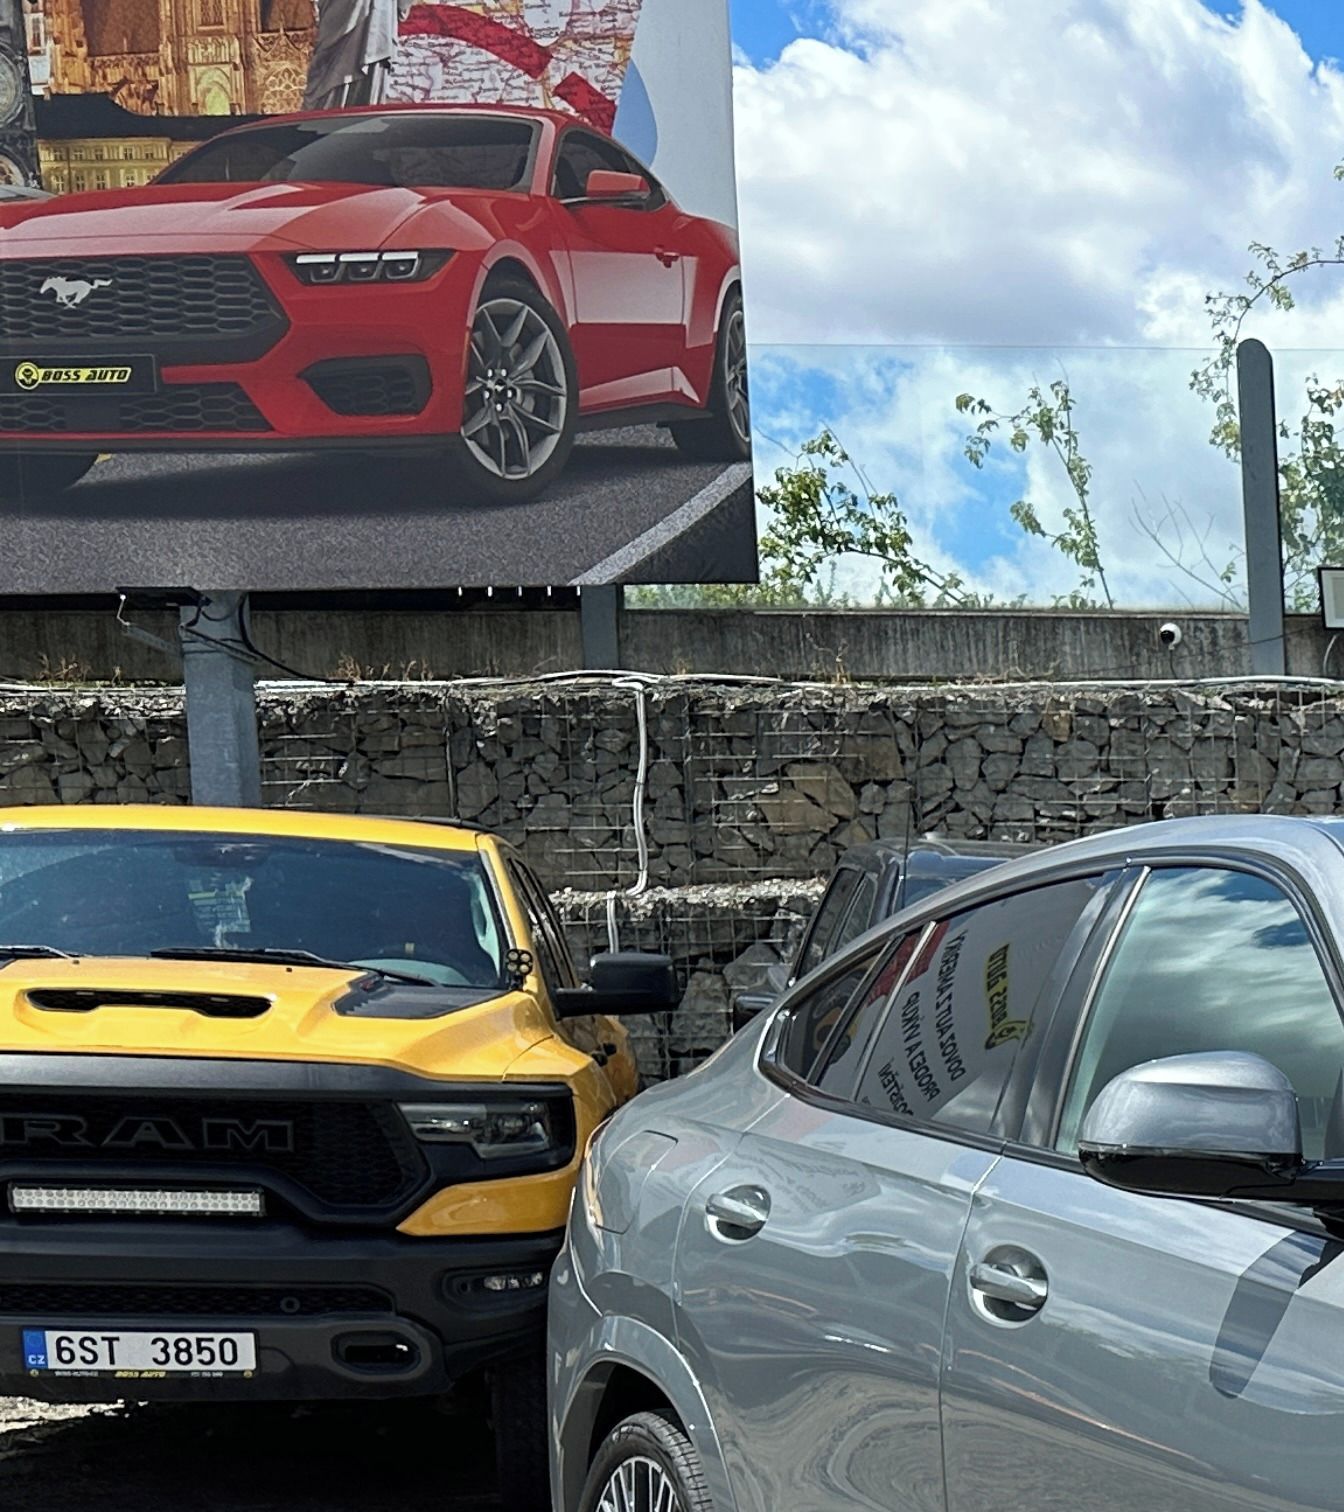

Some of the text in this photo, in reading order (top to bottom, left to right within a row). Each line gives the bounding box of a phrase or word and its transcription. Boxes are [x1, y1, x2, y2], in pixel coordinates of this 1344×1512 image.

[42, 369, 129, 381] BOSS AUTO
[0, 1114, 295, 1151] RAM
[28, 1353, 46, 1366] CZ
[55, 1336, 238, 1367] 6ST 3850
